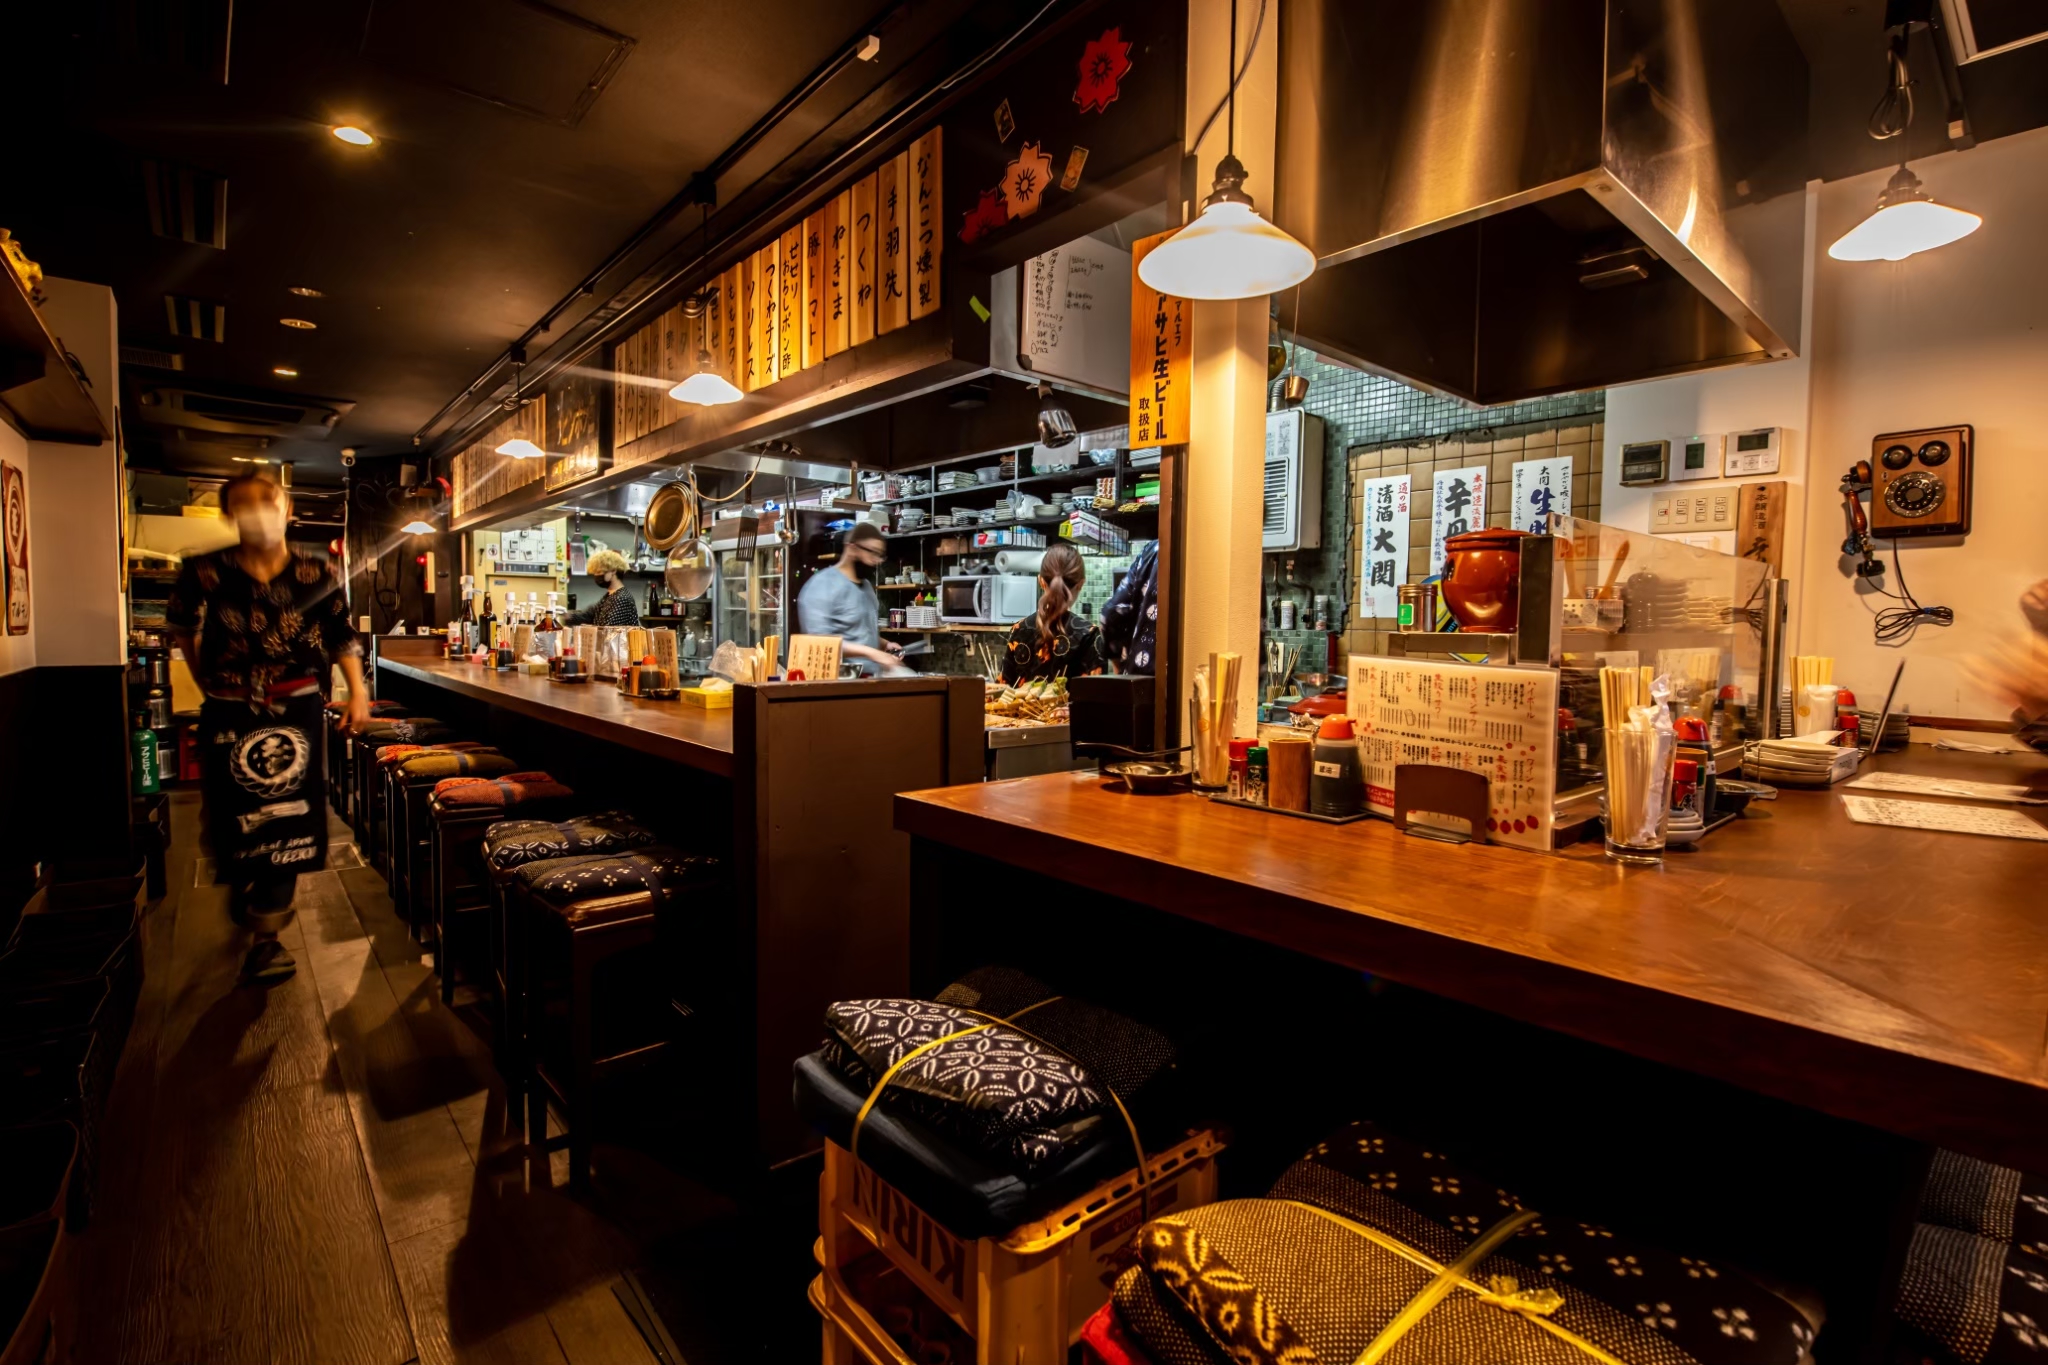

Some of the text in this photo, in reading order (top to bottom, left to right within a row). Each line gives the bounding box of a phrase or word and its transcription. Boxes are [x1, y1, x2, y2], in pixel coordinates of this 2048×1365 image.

[789, 241, 799, 300] せせり
[832, 224, 846, 320] ねぎま
[856, 213, 872, 307] つくね
[885, 185, 902, 302] 手羽先
[917, 153, 933, 307] なんこつ燻製
[765, 263, 776, 374] つくねチーズ
[782, 260, 792, 372] おろしポン酢
[1153, 291, 1171, 440] アサヒ生ビール
[1138, 398, 1150, 442] 取扱店
[1471, 473, 1483, 532] 本醸造淡麗
[853, 1164, 965, 1301] KIRIN
